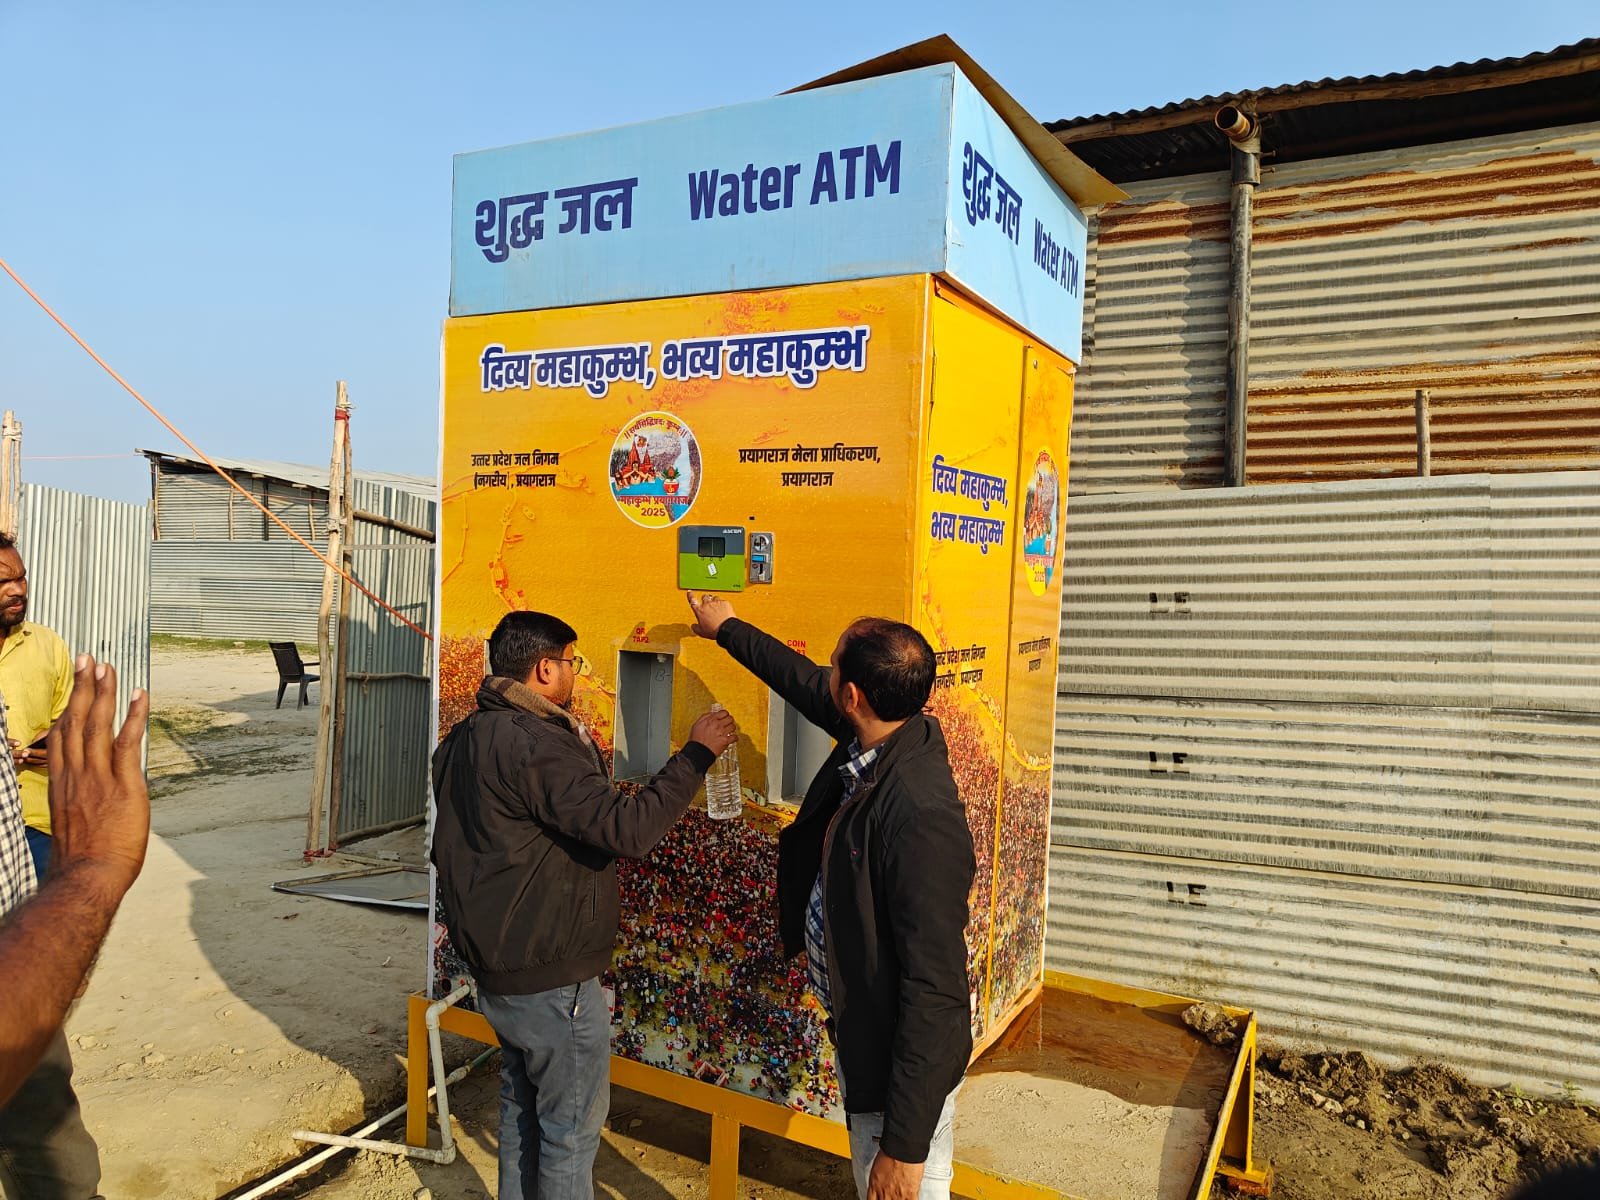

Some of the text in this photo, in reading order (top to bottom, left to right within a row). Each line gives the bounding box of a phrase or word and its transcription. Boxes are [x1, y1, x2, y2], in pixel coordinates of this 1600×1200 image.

[688, 140, 902, 220] Water ATM
[963, 142, 1022, 245] शुद्ध जल
[475, 177, 638, 263] शुद्ध जल
[1034, 218, 1079, 299] Water ATM
[482, 329, 866, 395] दिव्य महाकुम्भ, भव्य महाकुम्भ
[471, 449, 560, 467] उत्तर प्रदेश जल निगम
[739, 448, 790, 463] प्रयागराज
[791, 443, 819, 462] मेला
[516, 474, 556, 487] प्रयागराज
[781, 472, 834, 486] प्रयागराज
[932, 454, 959, 496] दिव्य
[641, 508, 666, 516] 2025
[931, 511, 1005, 554] भव्य महाकुम्भ
[787, 640, 806, 648] COIN
